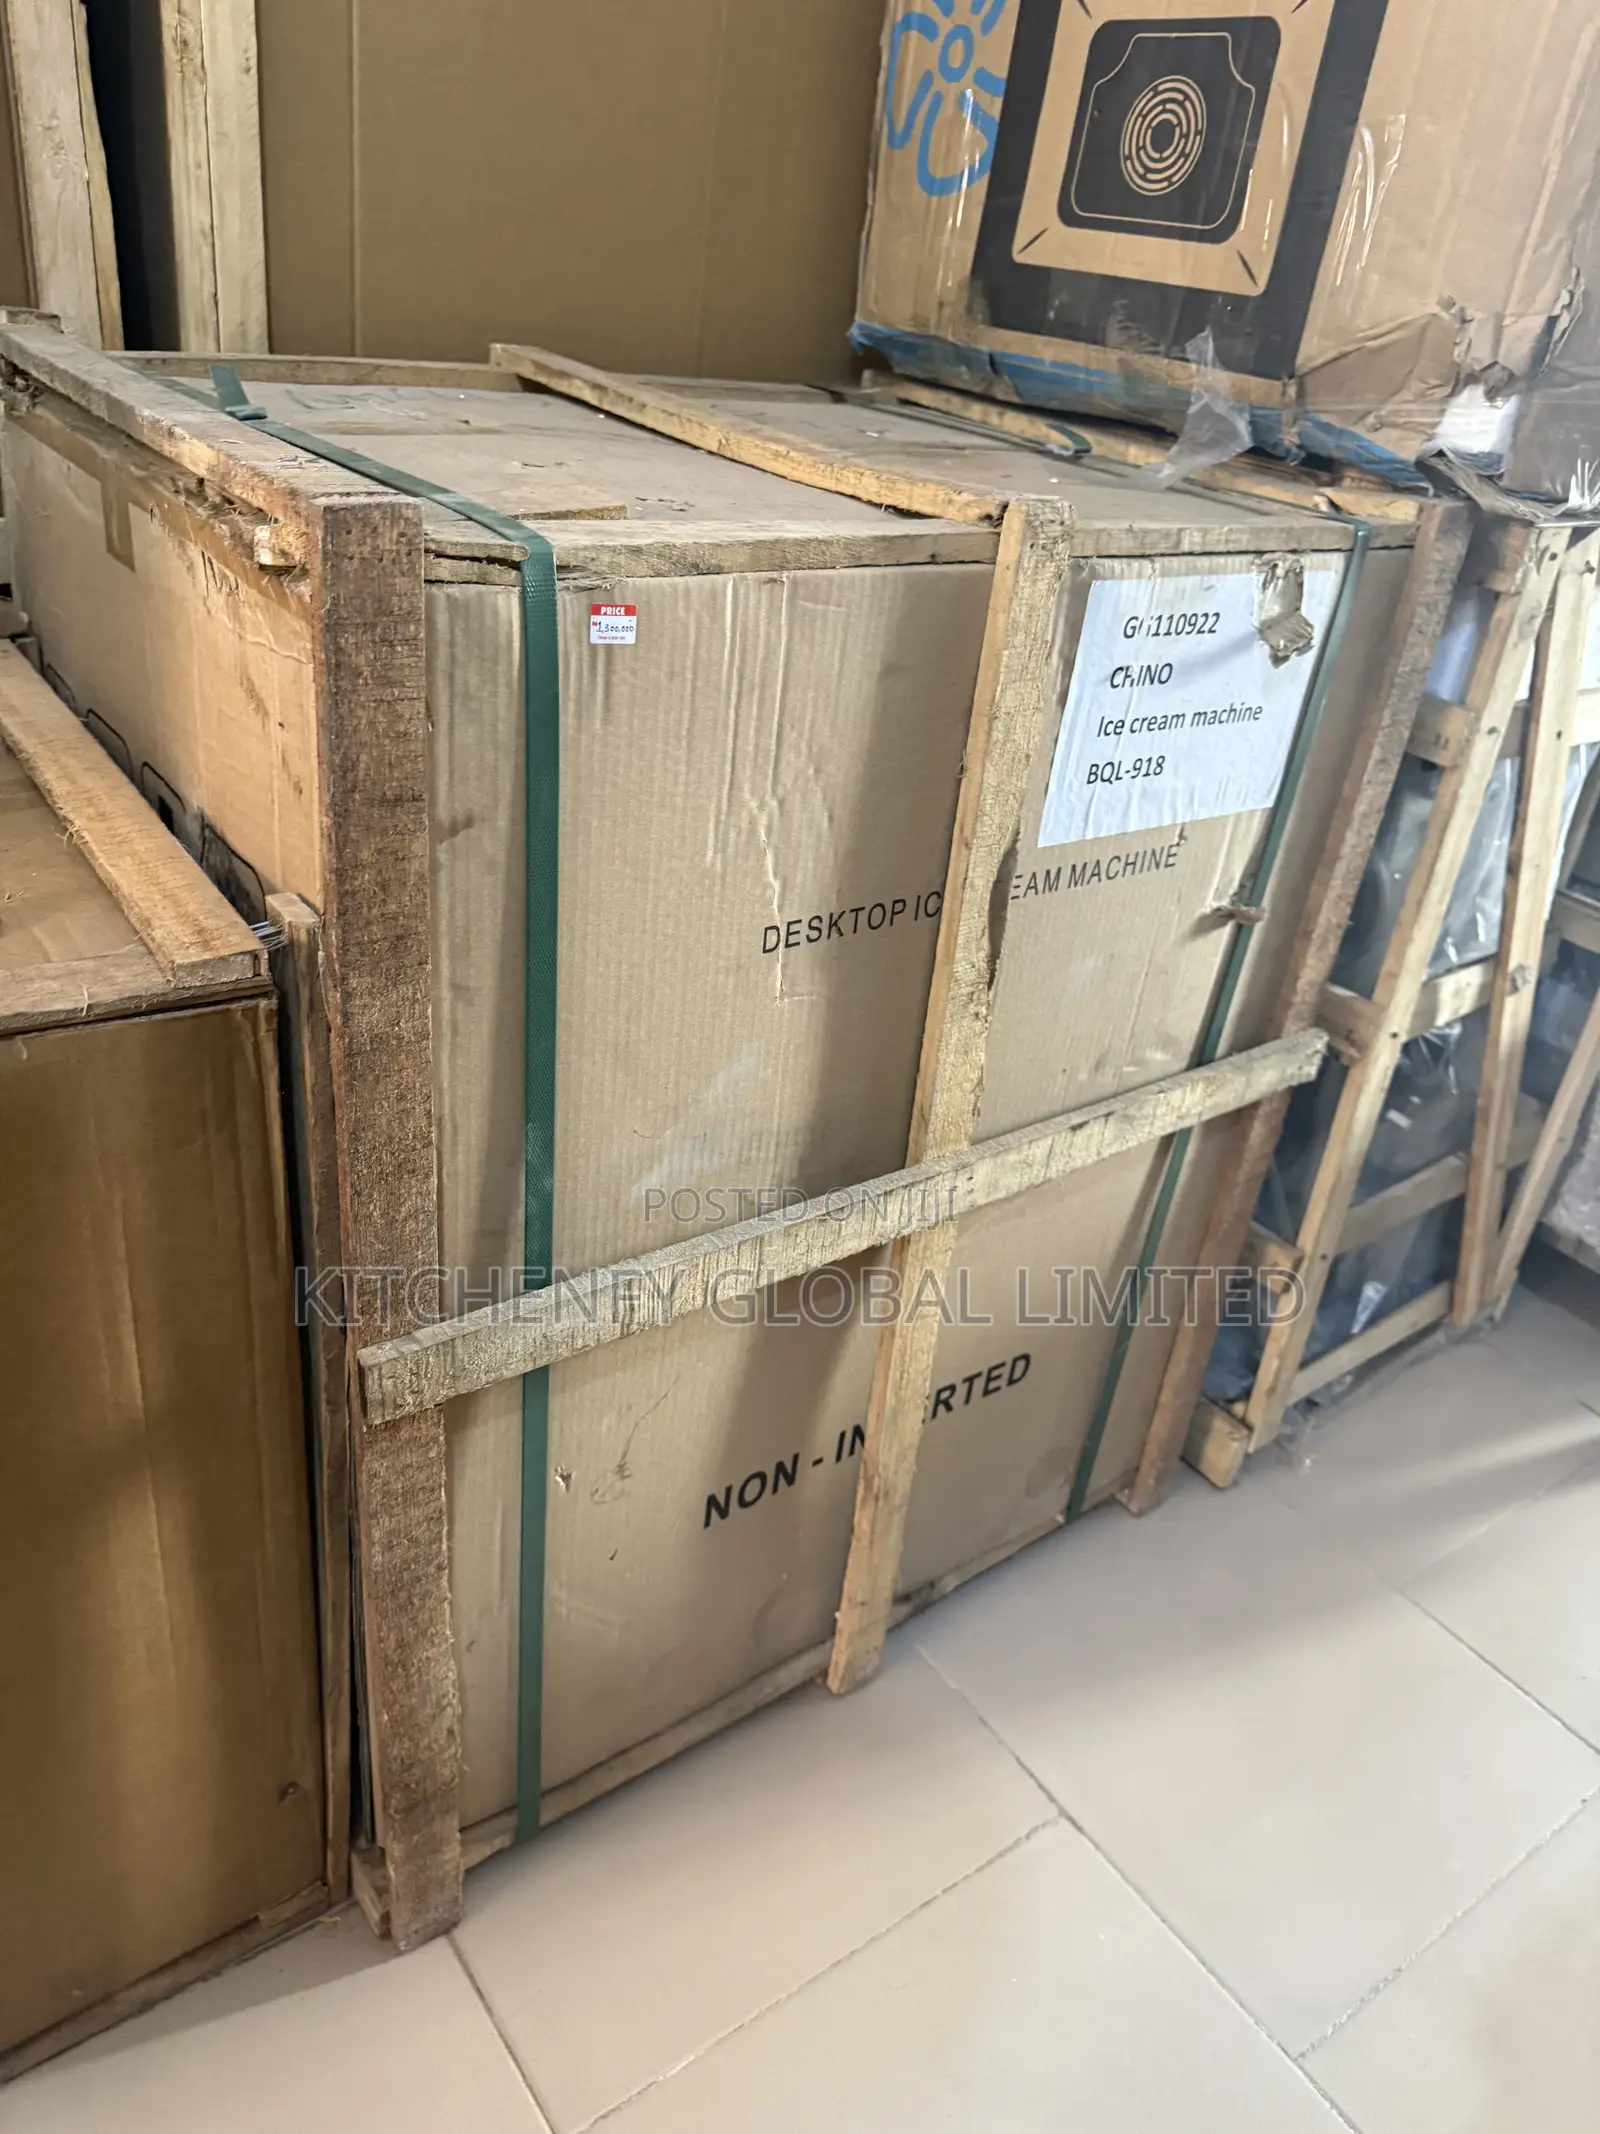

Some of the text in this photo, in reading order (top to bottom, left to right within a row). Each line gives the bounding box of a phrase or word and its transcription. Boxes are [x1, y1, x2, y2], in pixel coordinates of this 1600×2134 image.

[600, 606, 626, 615] PRICE
[1110, 662, 1173, 689] CHINO
[1097, 702, 1263, 738] Ice cream machine
[1086, 755, 1165, 785] BQL-918
[762, 898, 906, 954] DESKTOP
[1067, 843, 1180, 890] MACHINE
